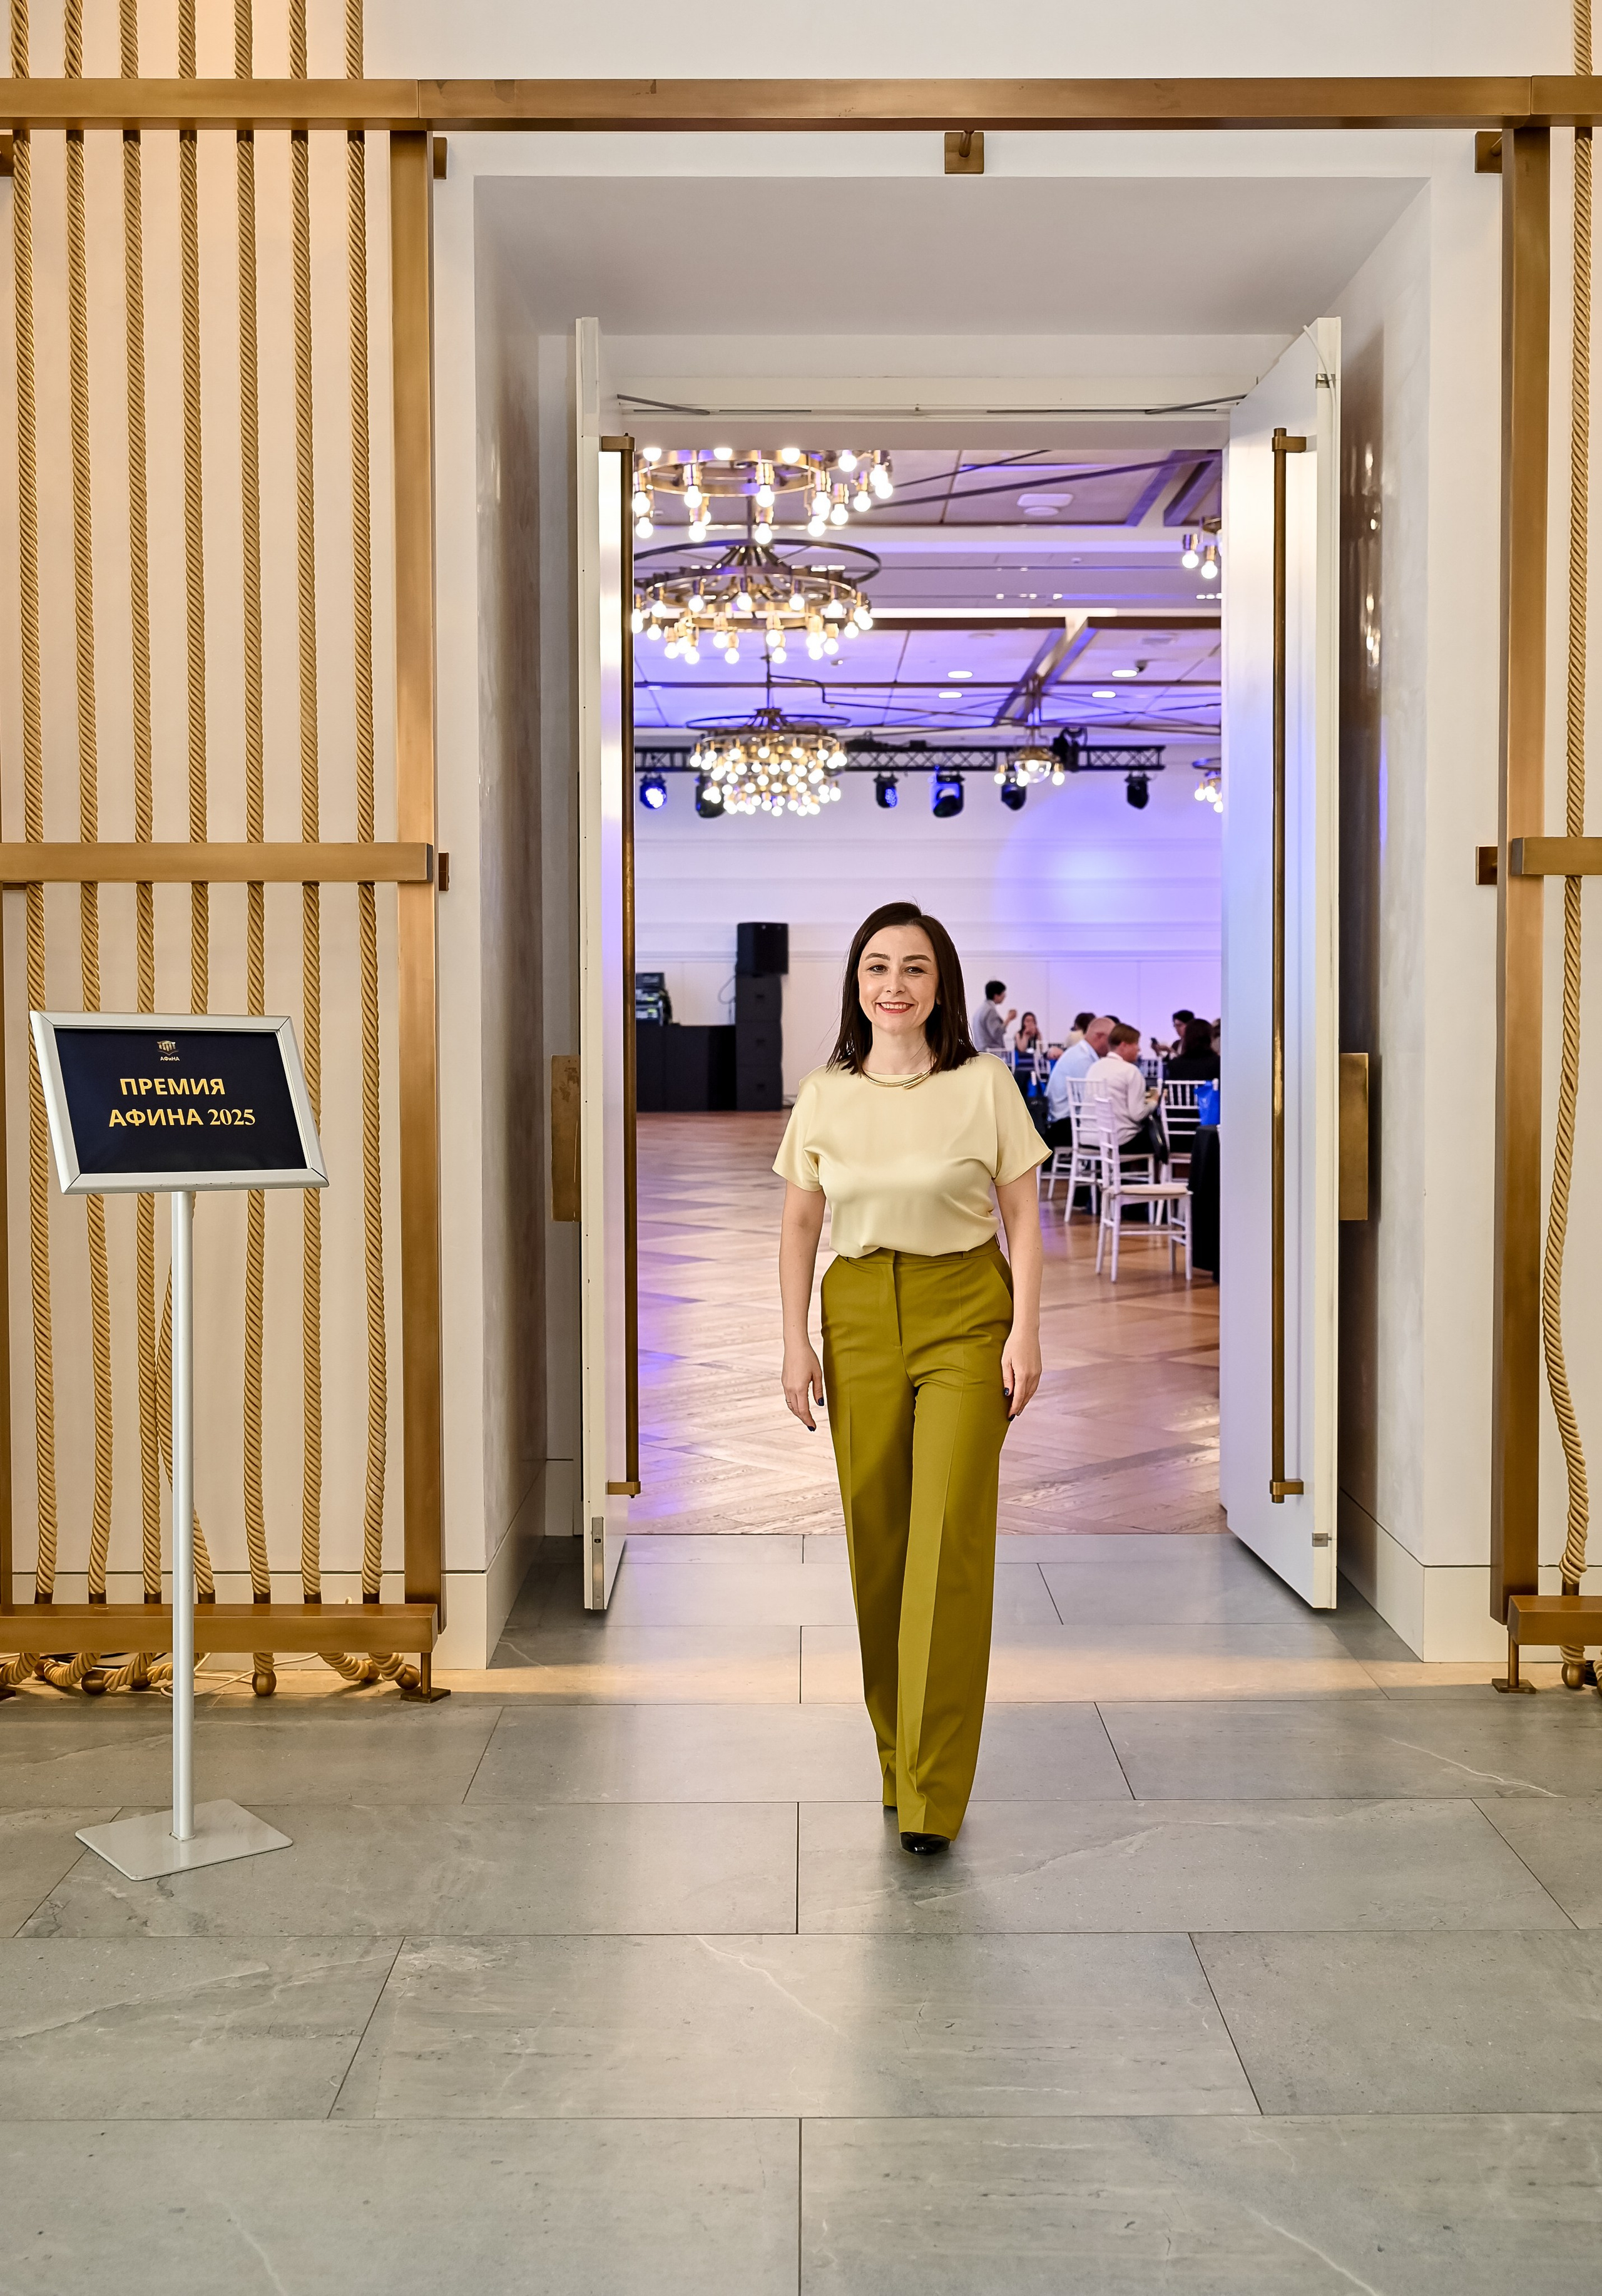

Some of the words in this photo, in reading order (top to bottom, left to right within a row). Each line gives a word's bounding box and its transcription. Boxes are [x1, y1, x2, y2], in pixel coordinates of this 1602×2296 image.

[120, 1078, 225, 1095] ПРЕМИЯ
[109, 1109, 204, 1127] АФИНА
[207, 1109, 255, 1125] 2025
